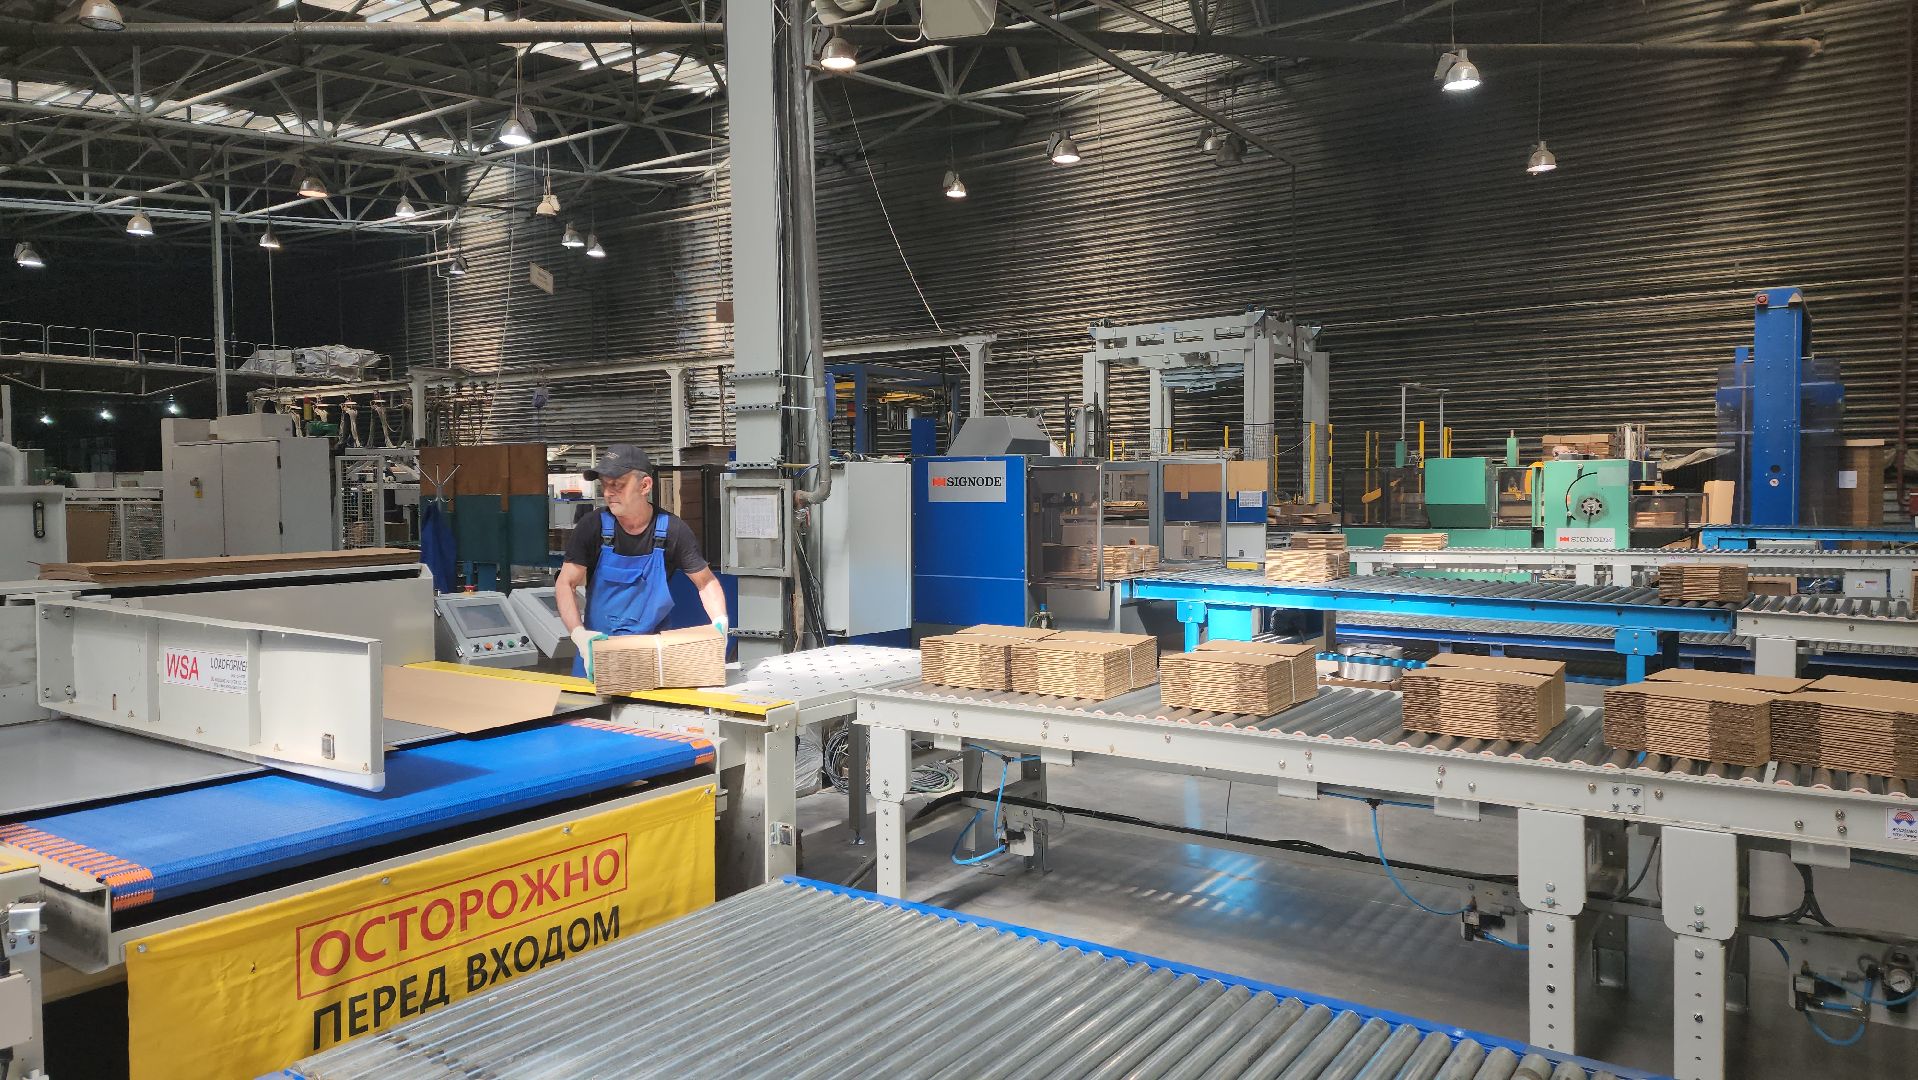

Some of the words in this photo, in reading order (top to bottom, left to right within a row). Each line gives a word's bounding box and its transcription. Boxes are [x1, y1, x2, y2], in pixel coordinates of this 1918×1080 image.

[947, 476, 1002, 487] SIGNODE
[166, 652, 199, 681] WSA
[310, 848, 620, 976] ОСТОРОЖНО
[313, 965, 450, 1050] ПЕРЕД
[467, 905, 620, 993] ВХОДОМ
